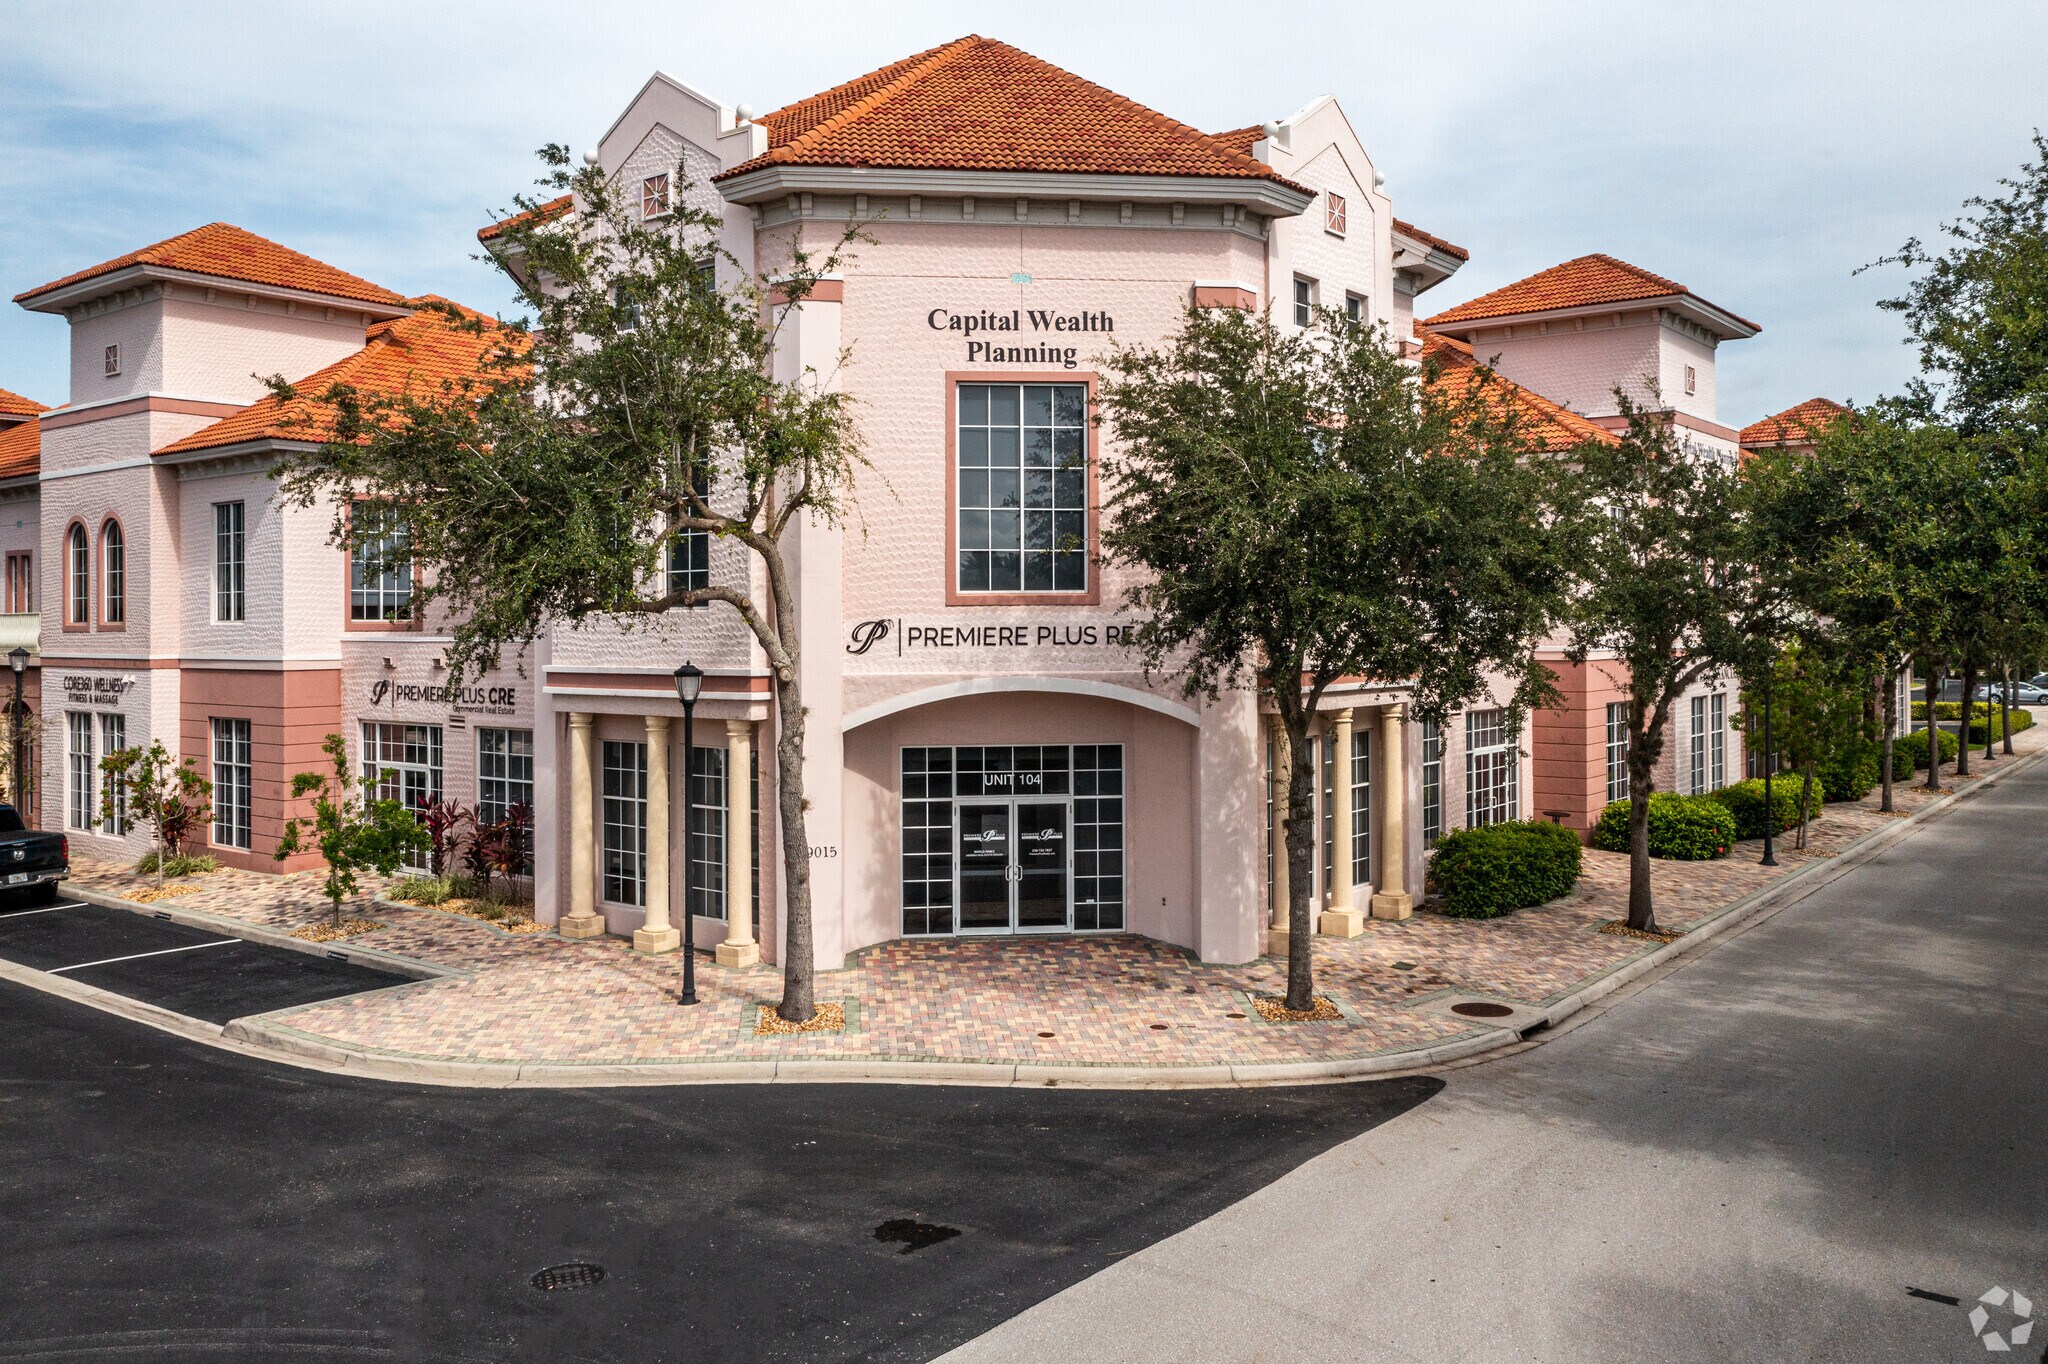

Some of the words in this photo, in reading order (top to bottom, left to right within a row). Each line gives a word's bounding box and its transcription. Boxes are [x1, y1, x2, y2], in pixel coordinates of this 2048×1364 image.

[928, 309, 1020, 336] Capital
[1027, 310, 1115, 332] Wealth
[966, 341, 1078, 369] Planning
[908, 626, 1029, 647] PREMIERE
[1037, 626, 1098, 645] PLUS
[63, 676, 93, 691] CORE360
[94, 677, 124, 693] WELLNESS
[68, 692, 88, 703] FITNESS
[94, 694, 119, 705] MASSAGE
[396, 685, 450, 703] PREMIERE
[455, 686, 485, 704] PLUS
[488, 687, 516, 706] CRE
[452, 705, 484, 715] Commercial
[485, 706, 497, 714] Real
[498, 706, 516, 716] Estate
[985, 774, 1015, 786] UNIT
[1019, 774, 1041, 785] 104
[807, 846, 837, 858] 9015
